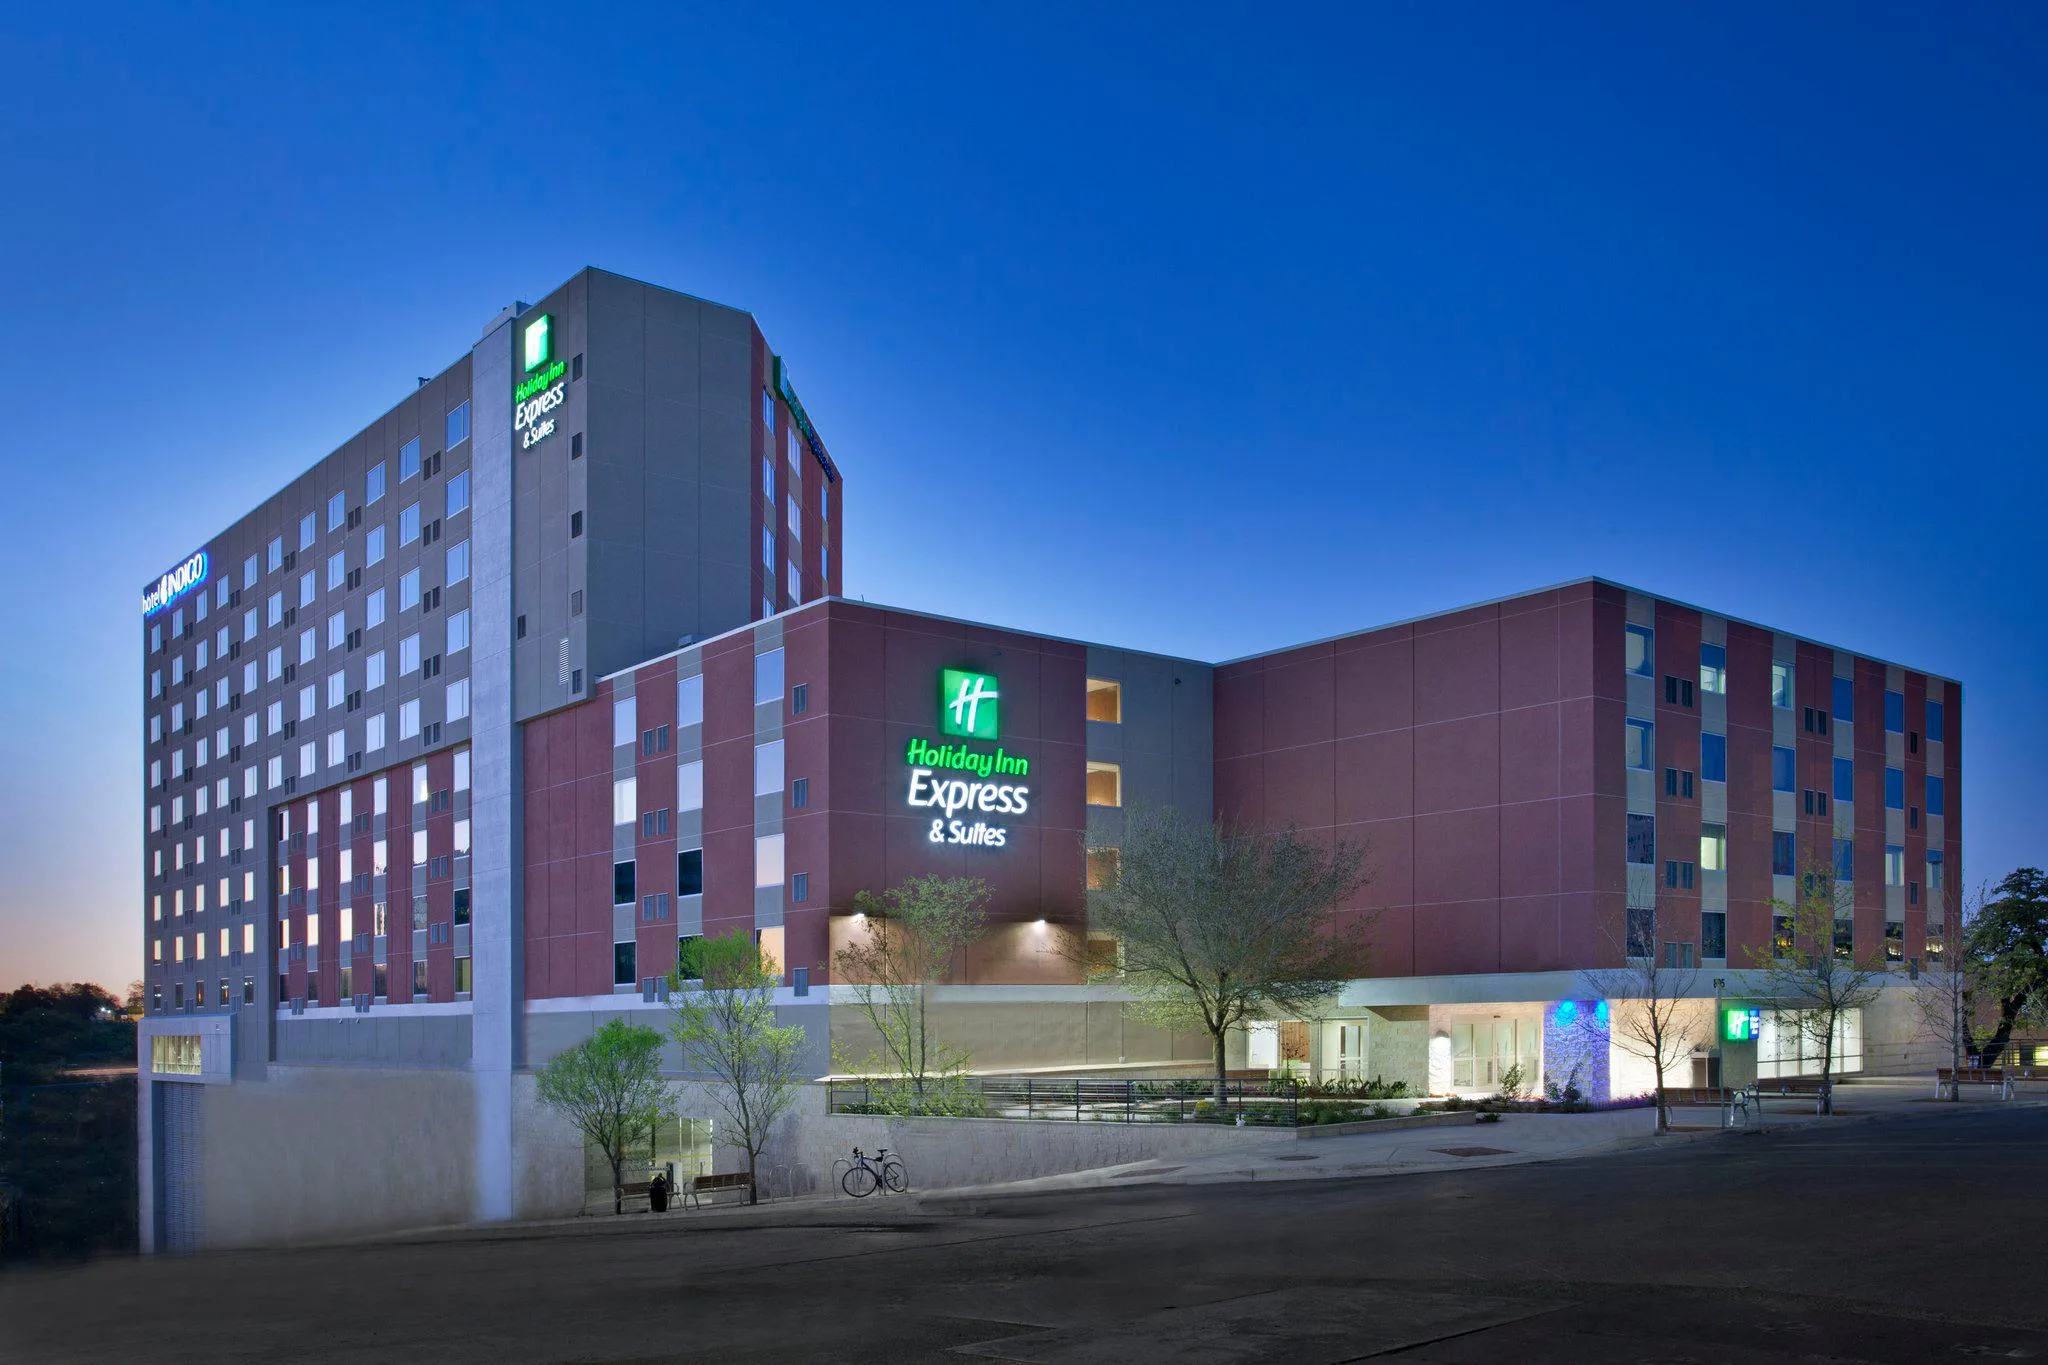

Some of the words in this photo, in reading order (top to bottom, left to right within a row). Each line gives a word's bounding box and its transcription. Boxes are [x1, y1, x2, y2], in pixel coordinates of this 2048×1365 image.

[516, 371, 549, 403] Holiday
[549, 361, 565, 382] Inn
[515, 382, 565, 431] Express
[523, 431, 531, 449] &
[530, 418, 555, 445] Suites
[142, 583, 161, 615] hotel
[908, 738, 993, 778] Holiday
[995, 747, 1028, 776] Inn
[908, 768, 1029, 819] Express
[929, 818, 945, 843] &
[947, 819, 1006, 847] Suites
